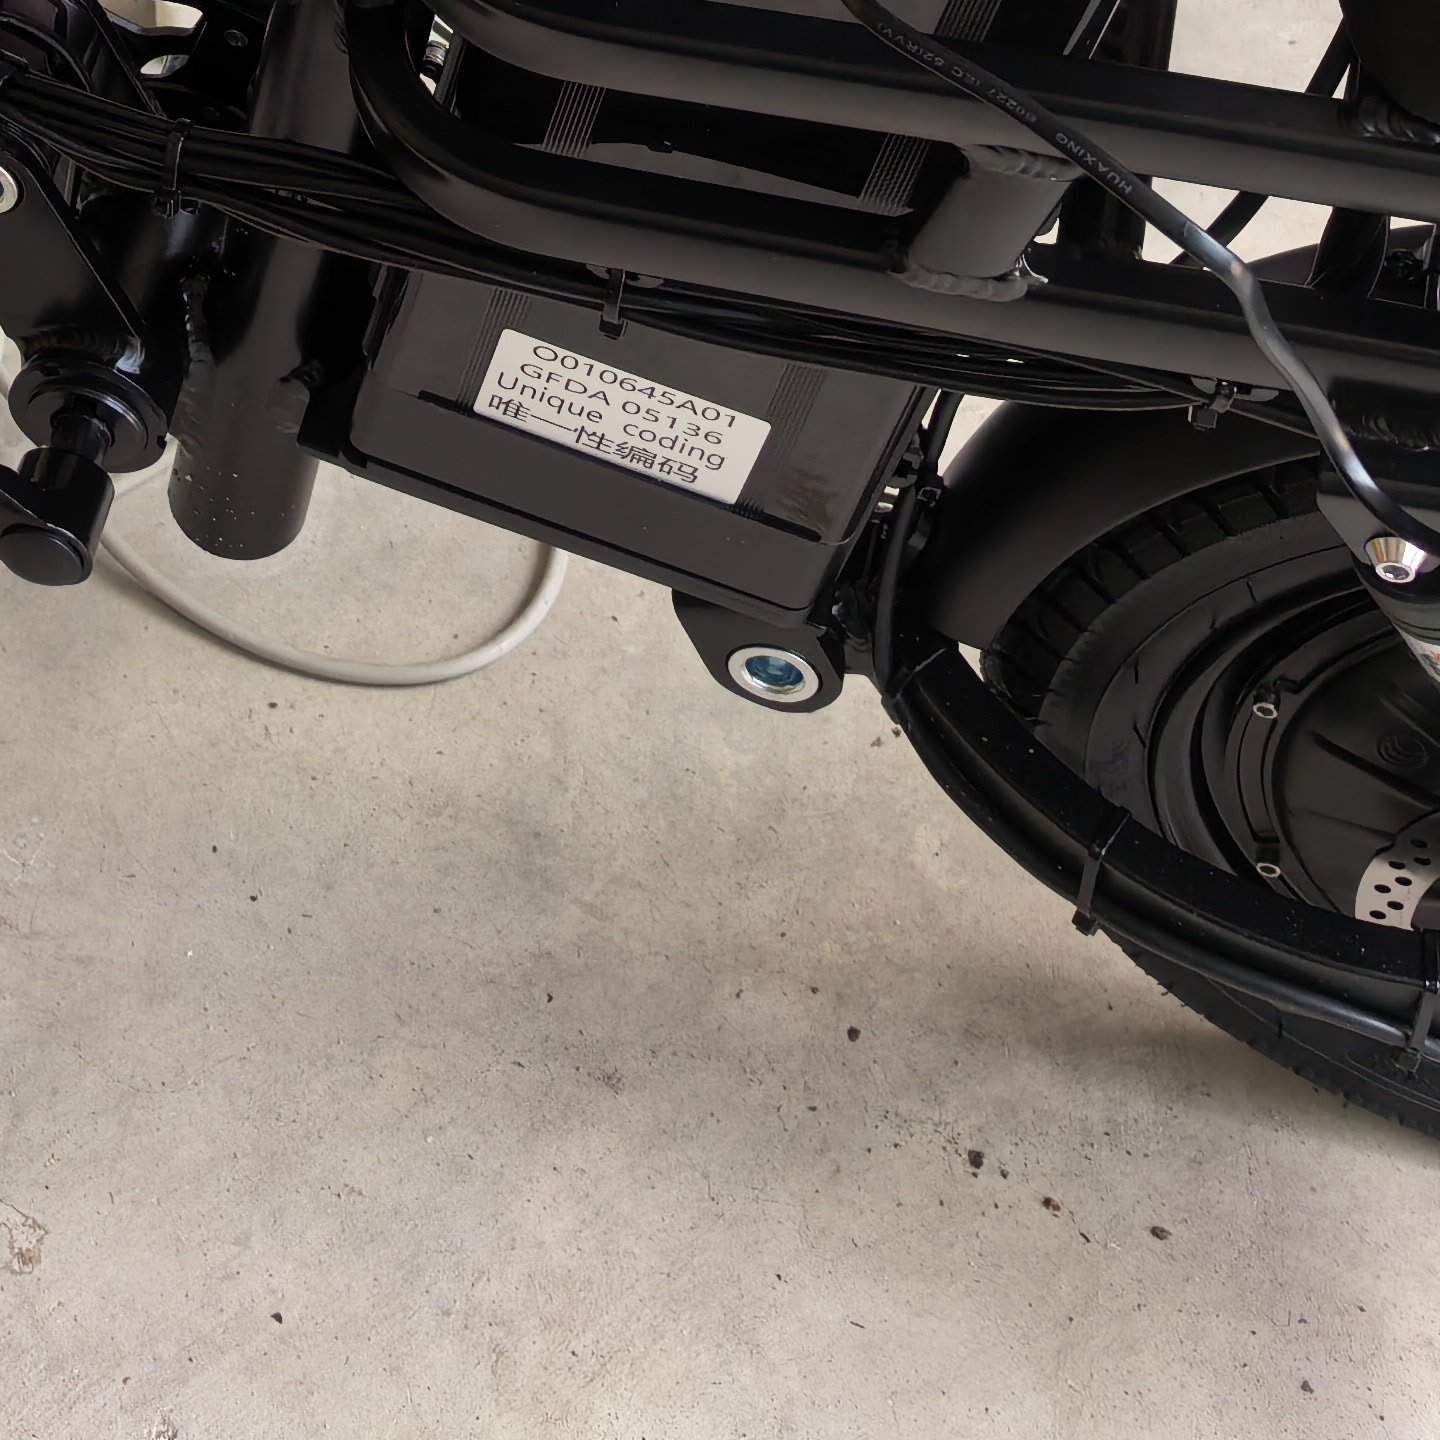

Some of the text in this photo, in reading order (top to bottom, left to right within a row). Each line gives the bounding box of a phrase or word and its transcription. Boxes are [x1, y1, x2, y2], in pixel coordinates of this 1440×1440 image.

[1054, 132, 1133, 196] HUAXING
[497, 371, 726, 471] Unique coding
[520, 363, 611, 407] GFDA
[488, 394, 698, 484] 唯一性编码
